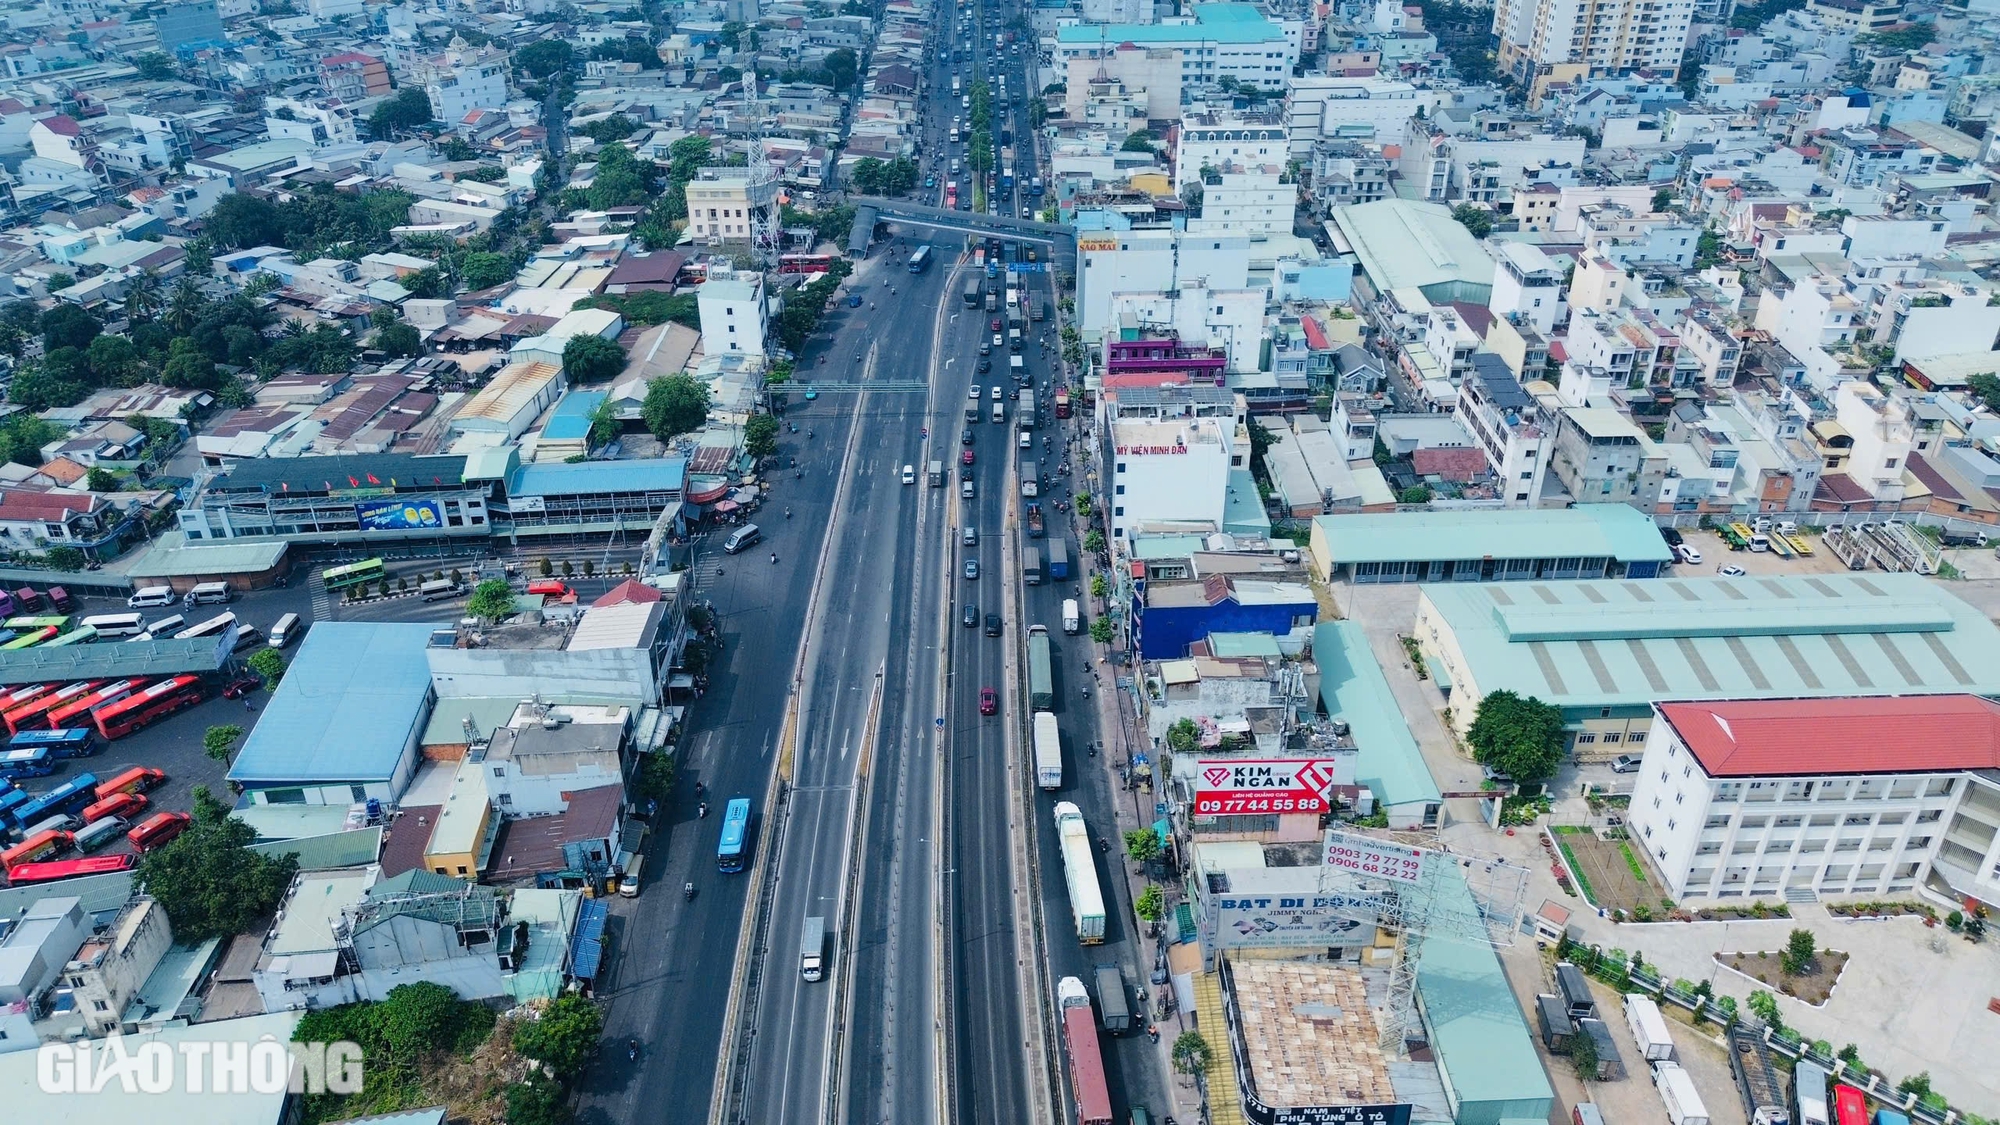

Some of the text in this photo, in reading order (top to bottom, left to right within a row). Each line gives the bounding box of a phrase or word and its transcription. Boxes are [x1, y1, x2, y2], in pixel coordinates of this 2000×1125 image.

[1150, 446, 1170, 454] MINH
[1234, 767, 1271, 776] KIM
[1234, 778, 1290, 787] NGAN
[1298, 799, 1320, 810] 88
[1329, 846, 1418, 870] 0903 79 77 99
[1328, 856, 1416, 880] 0906 68 22 22
[1221, 899, 1271, 912] BẠT
[1280, 898, 1304, 908] DI
[1340, 1106, 1362, 1114] VIỆT
[1280, 1115, 1305, 1123] PHỤ
[1368, 1112, 1384, 1120] TÔ
